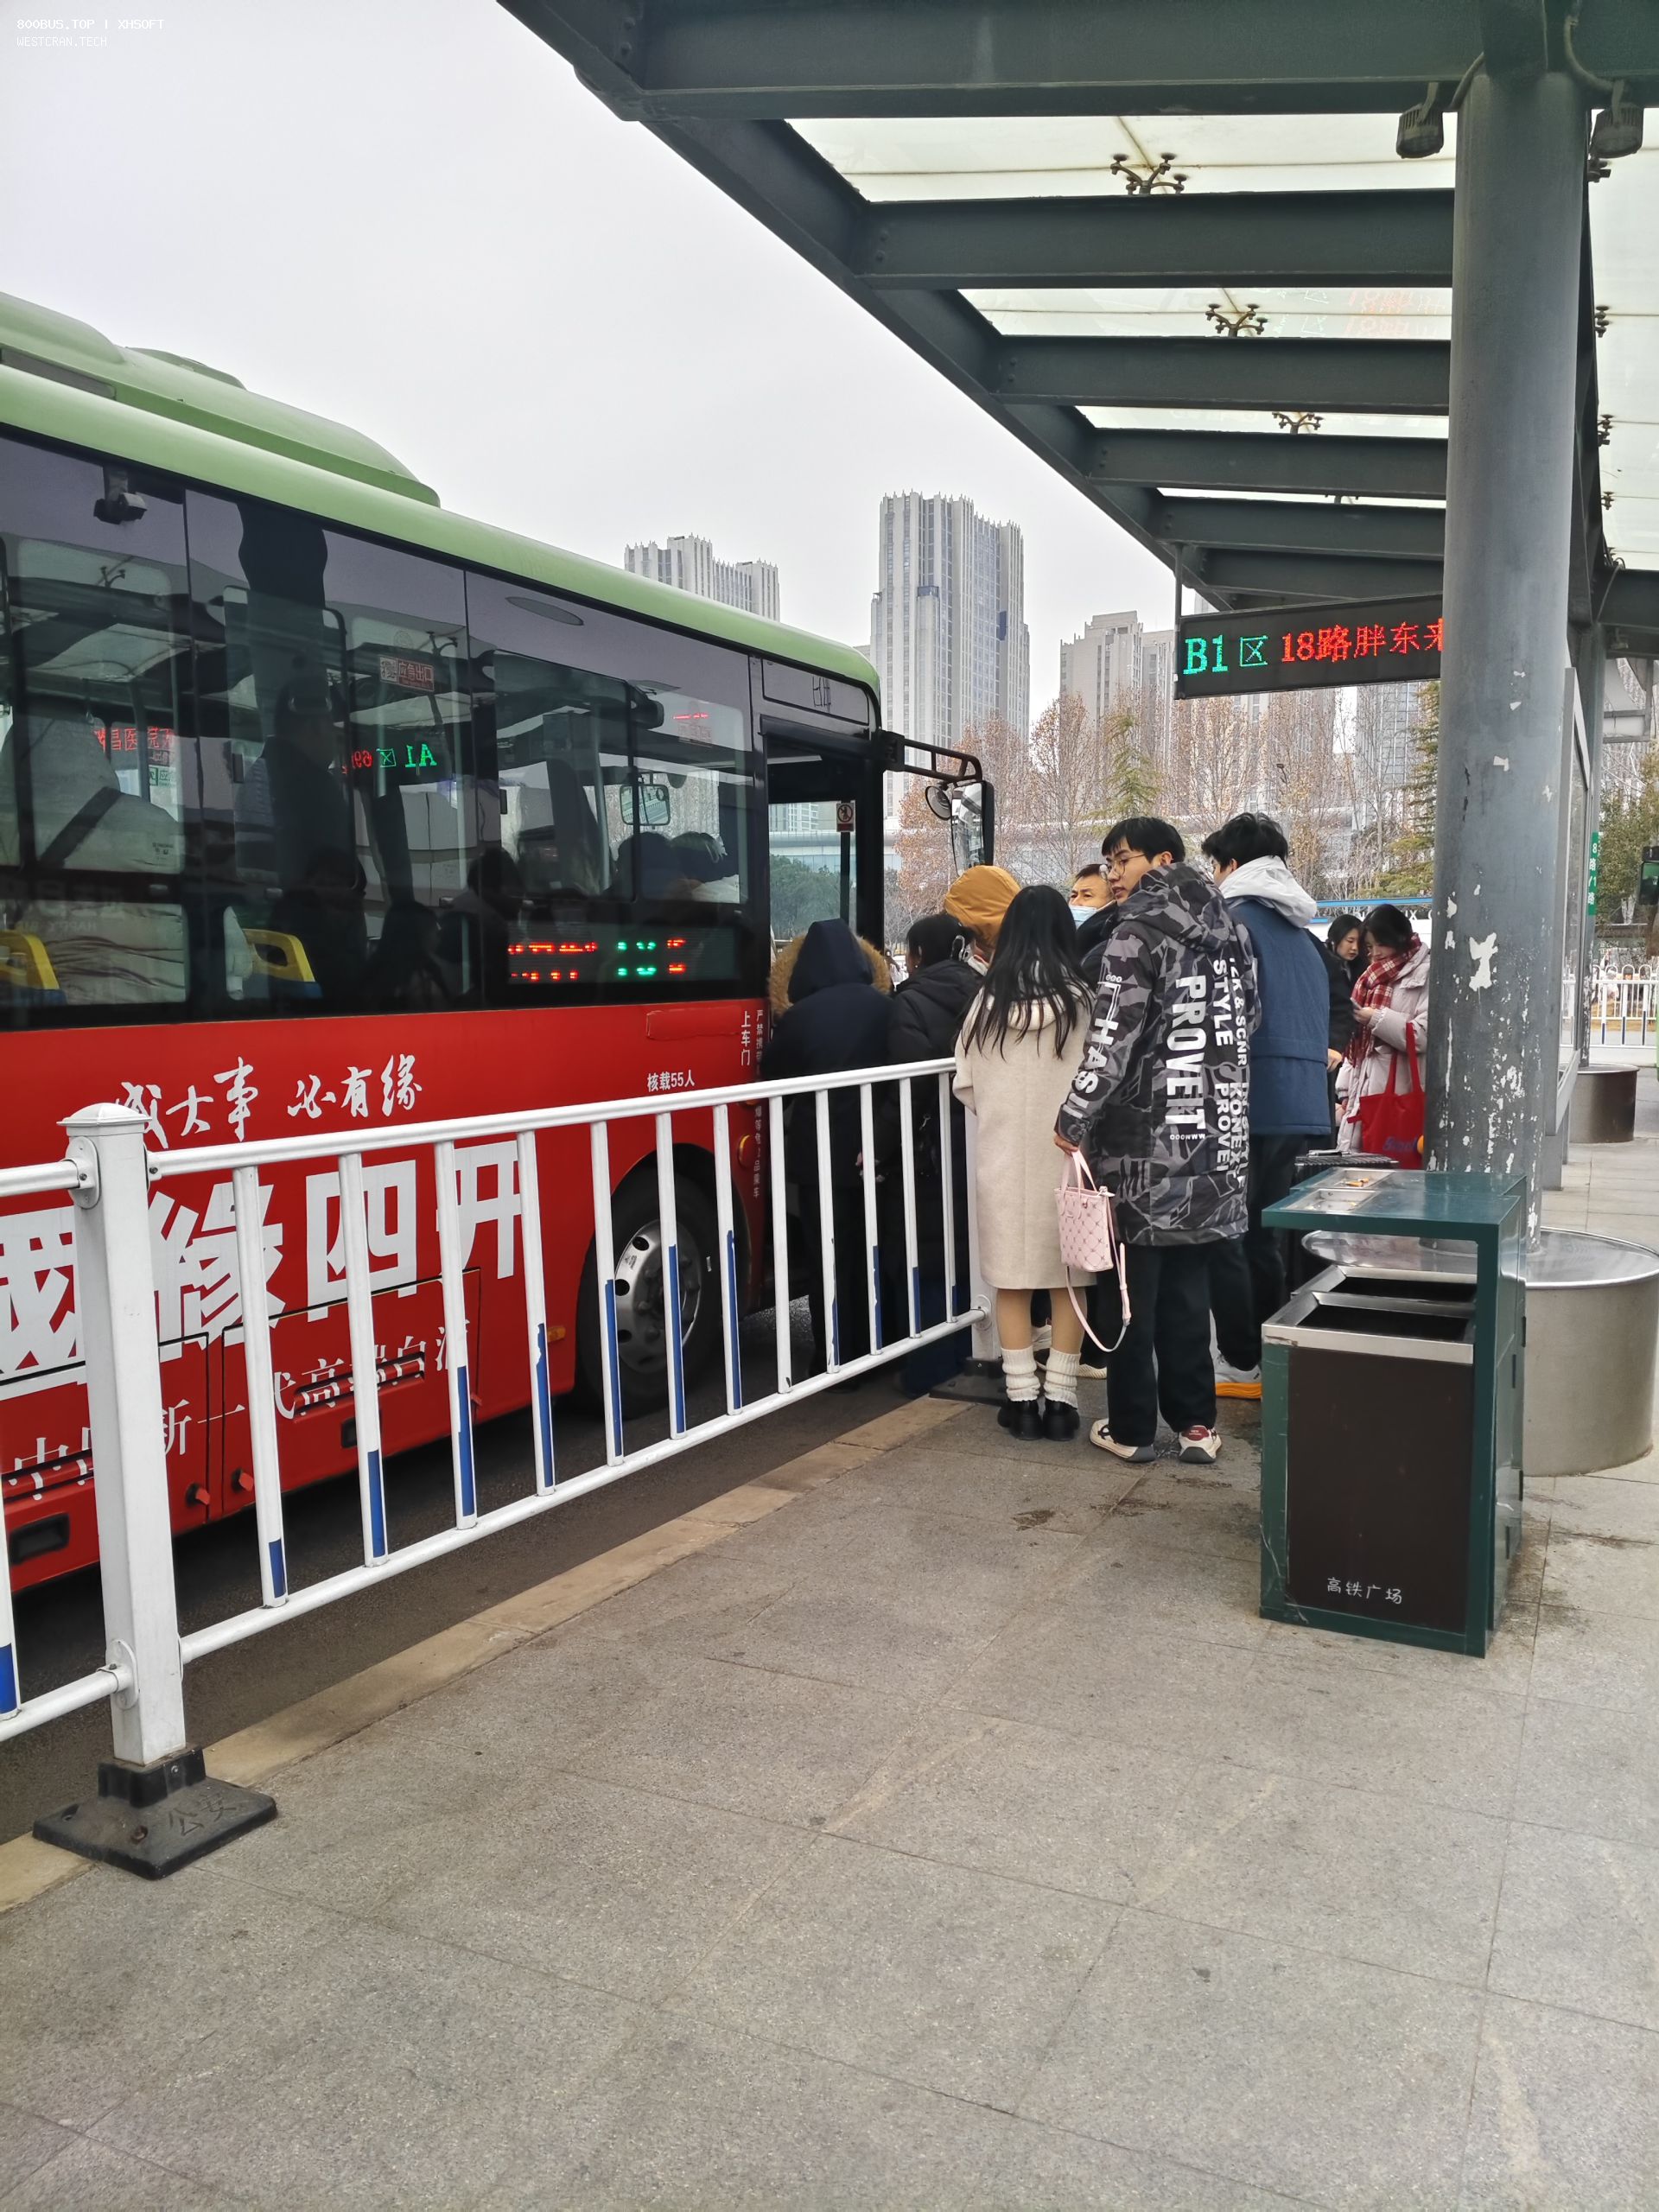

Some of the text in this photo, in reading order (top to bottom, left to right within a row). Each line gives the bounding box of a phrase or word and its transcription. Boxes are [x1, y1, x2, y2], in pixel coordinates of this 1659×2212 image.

[1184, 634, 1228, 674] B1
[1239, 635, 1268, 667] 区
[1212, 959, 1233, 1046] STYLE
[1234, 996, 1244, 1008] &
[741, 1010, 751, 1066] 上车门
[1235, 1015, 1247, 1066] SCNR
[647, 1070, 696, 1092] 核载55人
[1327, 1577, 1402, 1605] 高铁广场
